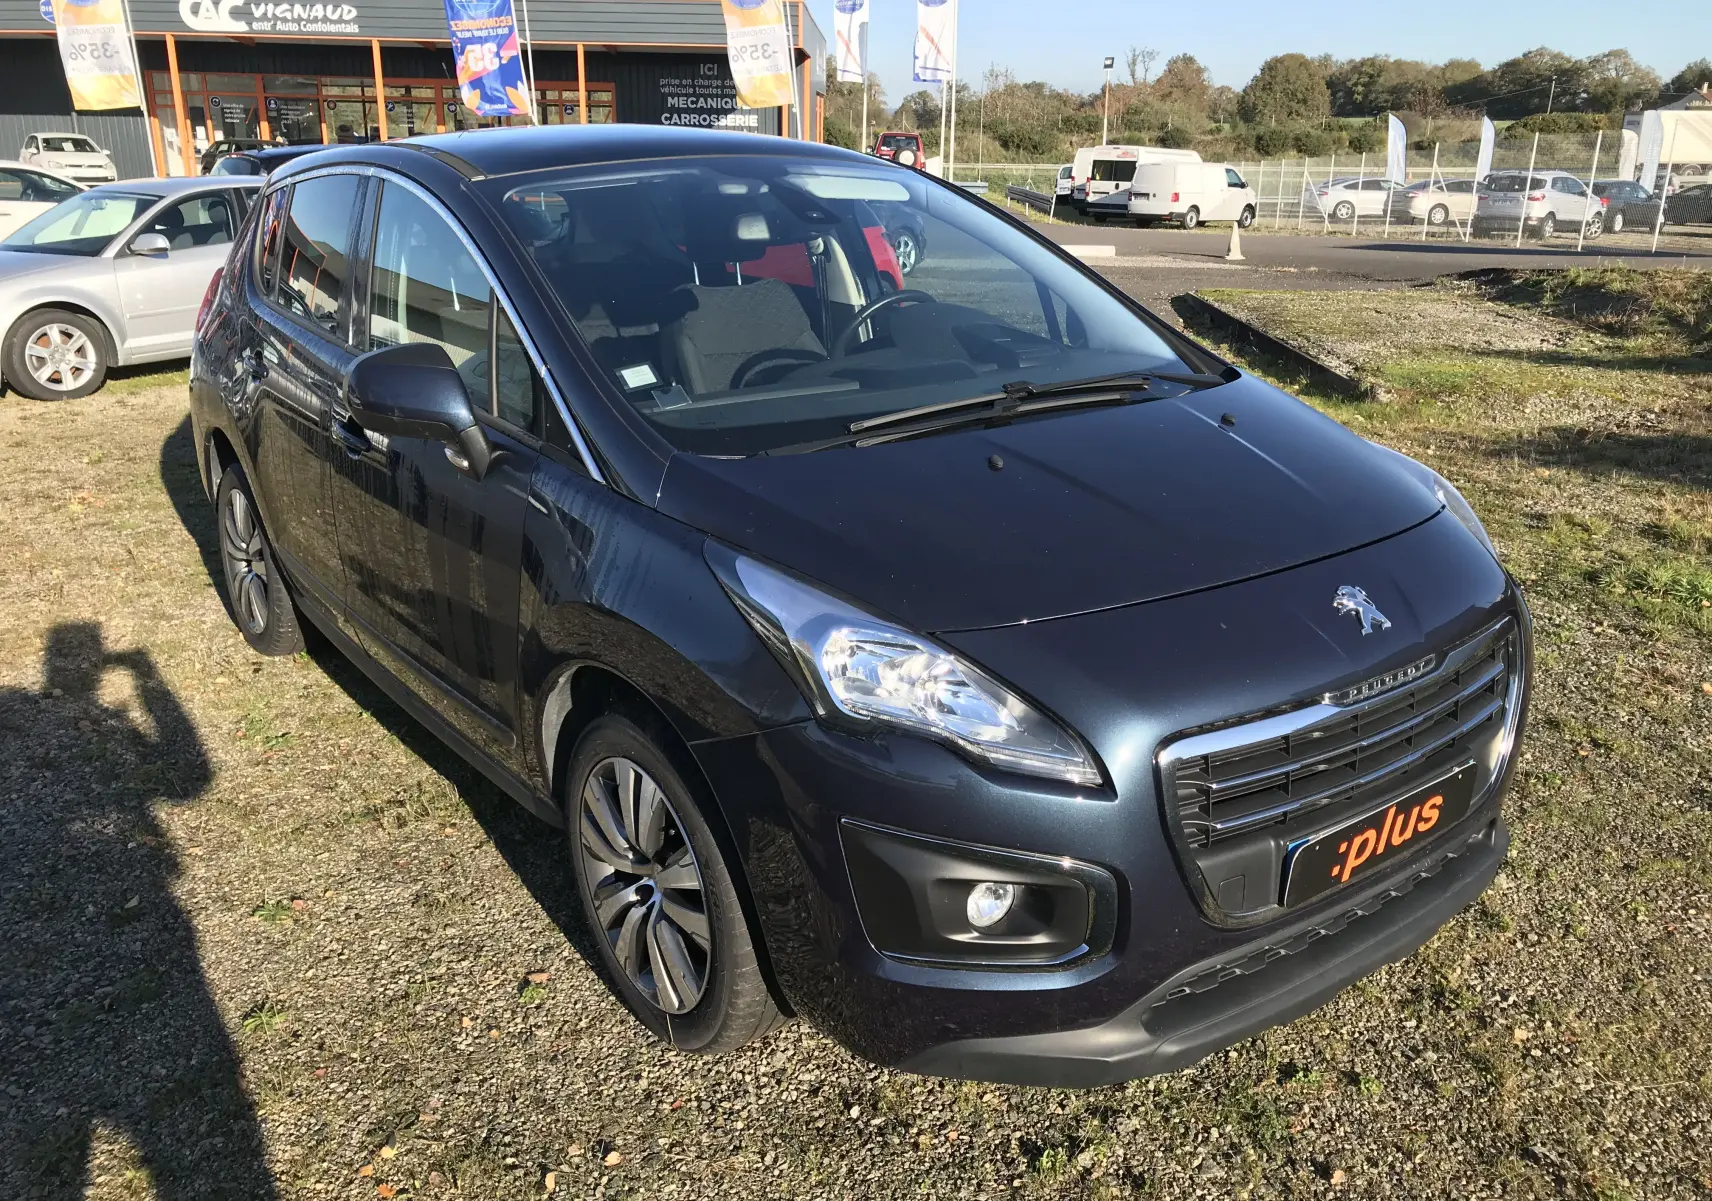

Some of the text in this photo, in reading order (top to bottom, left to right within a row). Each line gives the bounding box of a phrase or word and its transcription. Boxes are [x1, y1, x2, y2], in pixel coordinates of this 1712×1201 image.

[250, 2, 358, 21] VIGNAUD
[276, 21, 299, 32] Auto
[300, 21, 360, 33] Confolentais
[700, 63, 718, 75] ICI
[660, 77, 680, 86] prise
[694, 78, 722, 87] charge
[660, 85, 694, 94] véhicule
[696, 86, 722, 95] toutes
[661, 113, 759, 127] CARROSSERIE
[1349, 661, 1425, 699] PEUGEOT
